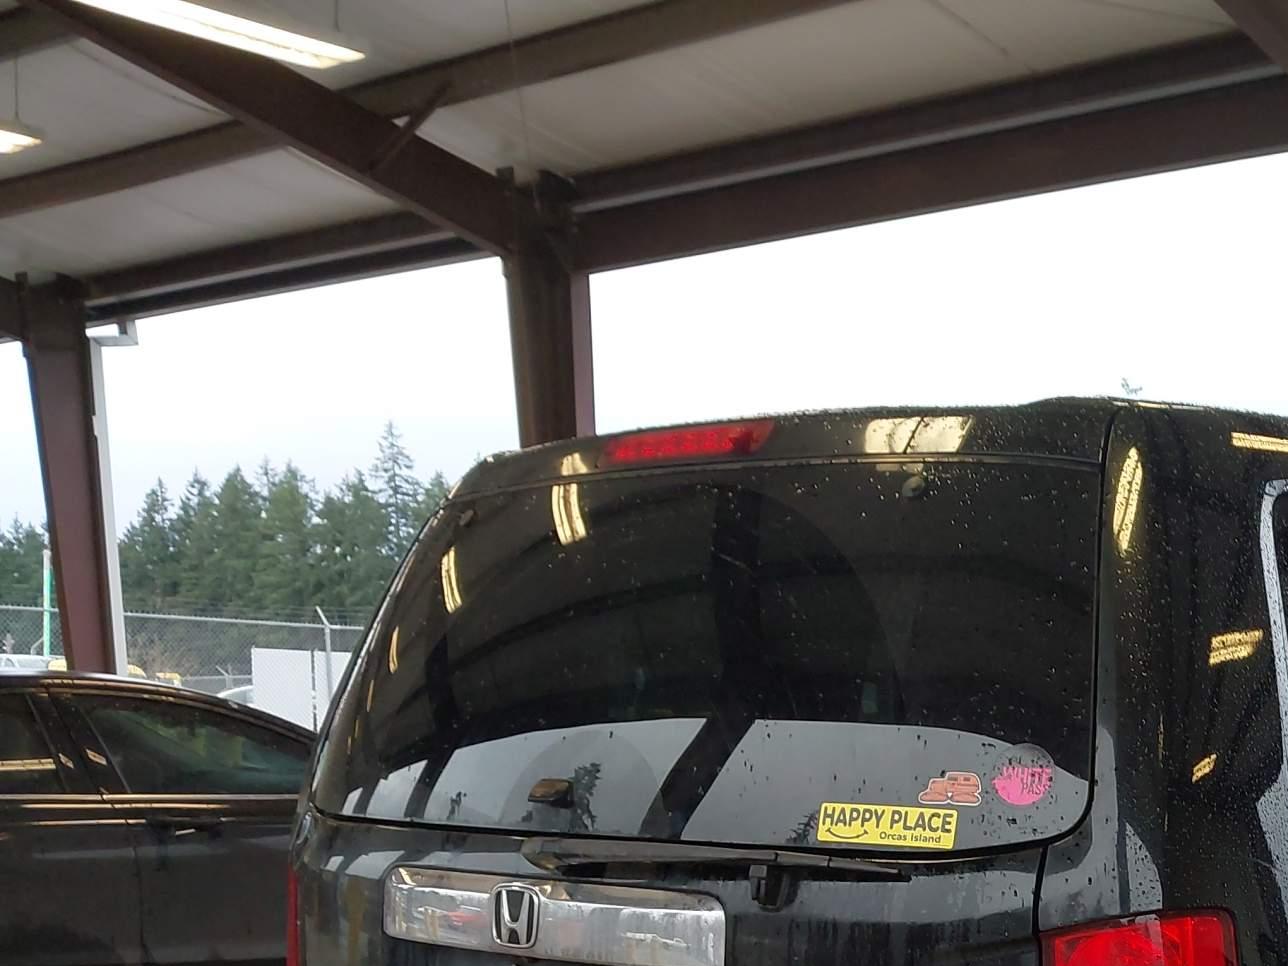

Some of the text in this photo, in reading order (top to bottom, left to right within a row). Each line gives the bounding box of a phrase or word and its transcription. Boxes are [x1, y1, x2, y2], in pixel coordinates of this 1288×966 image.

[1002, 766, 1051, 785] WHITE
[822, 806, 954, 833] HAPPY PLACE
[880, 831, 941, 844] Orcas Island
